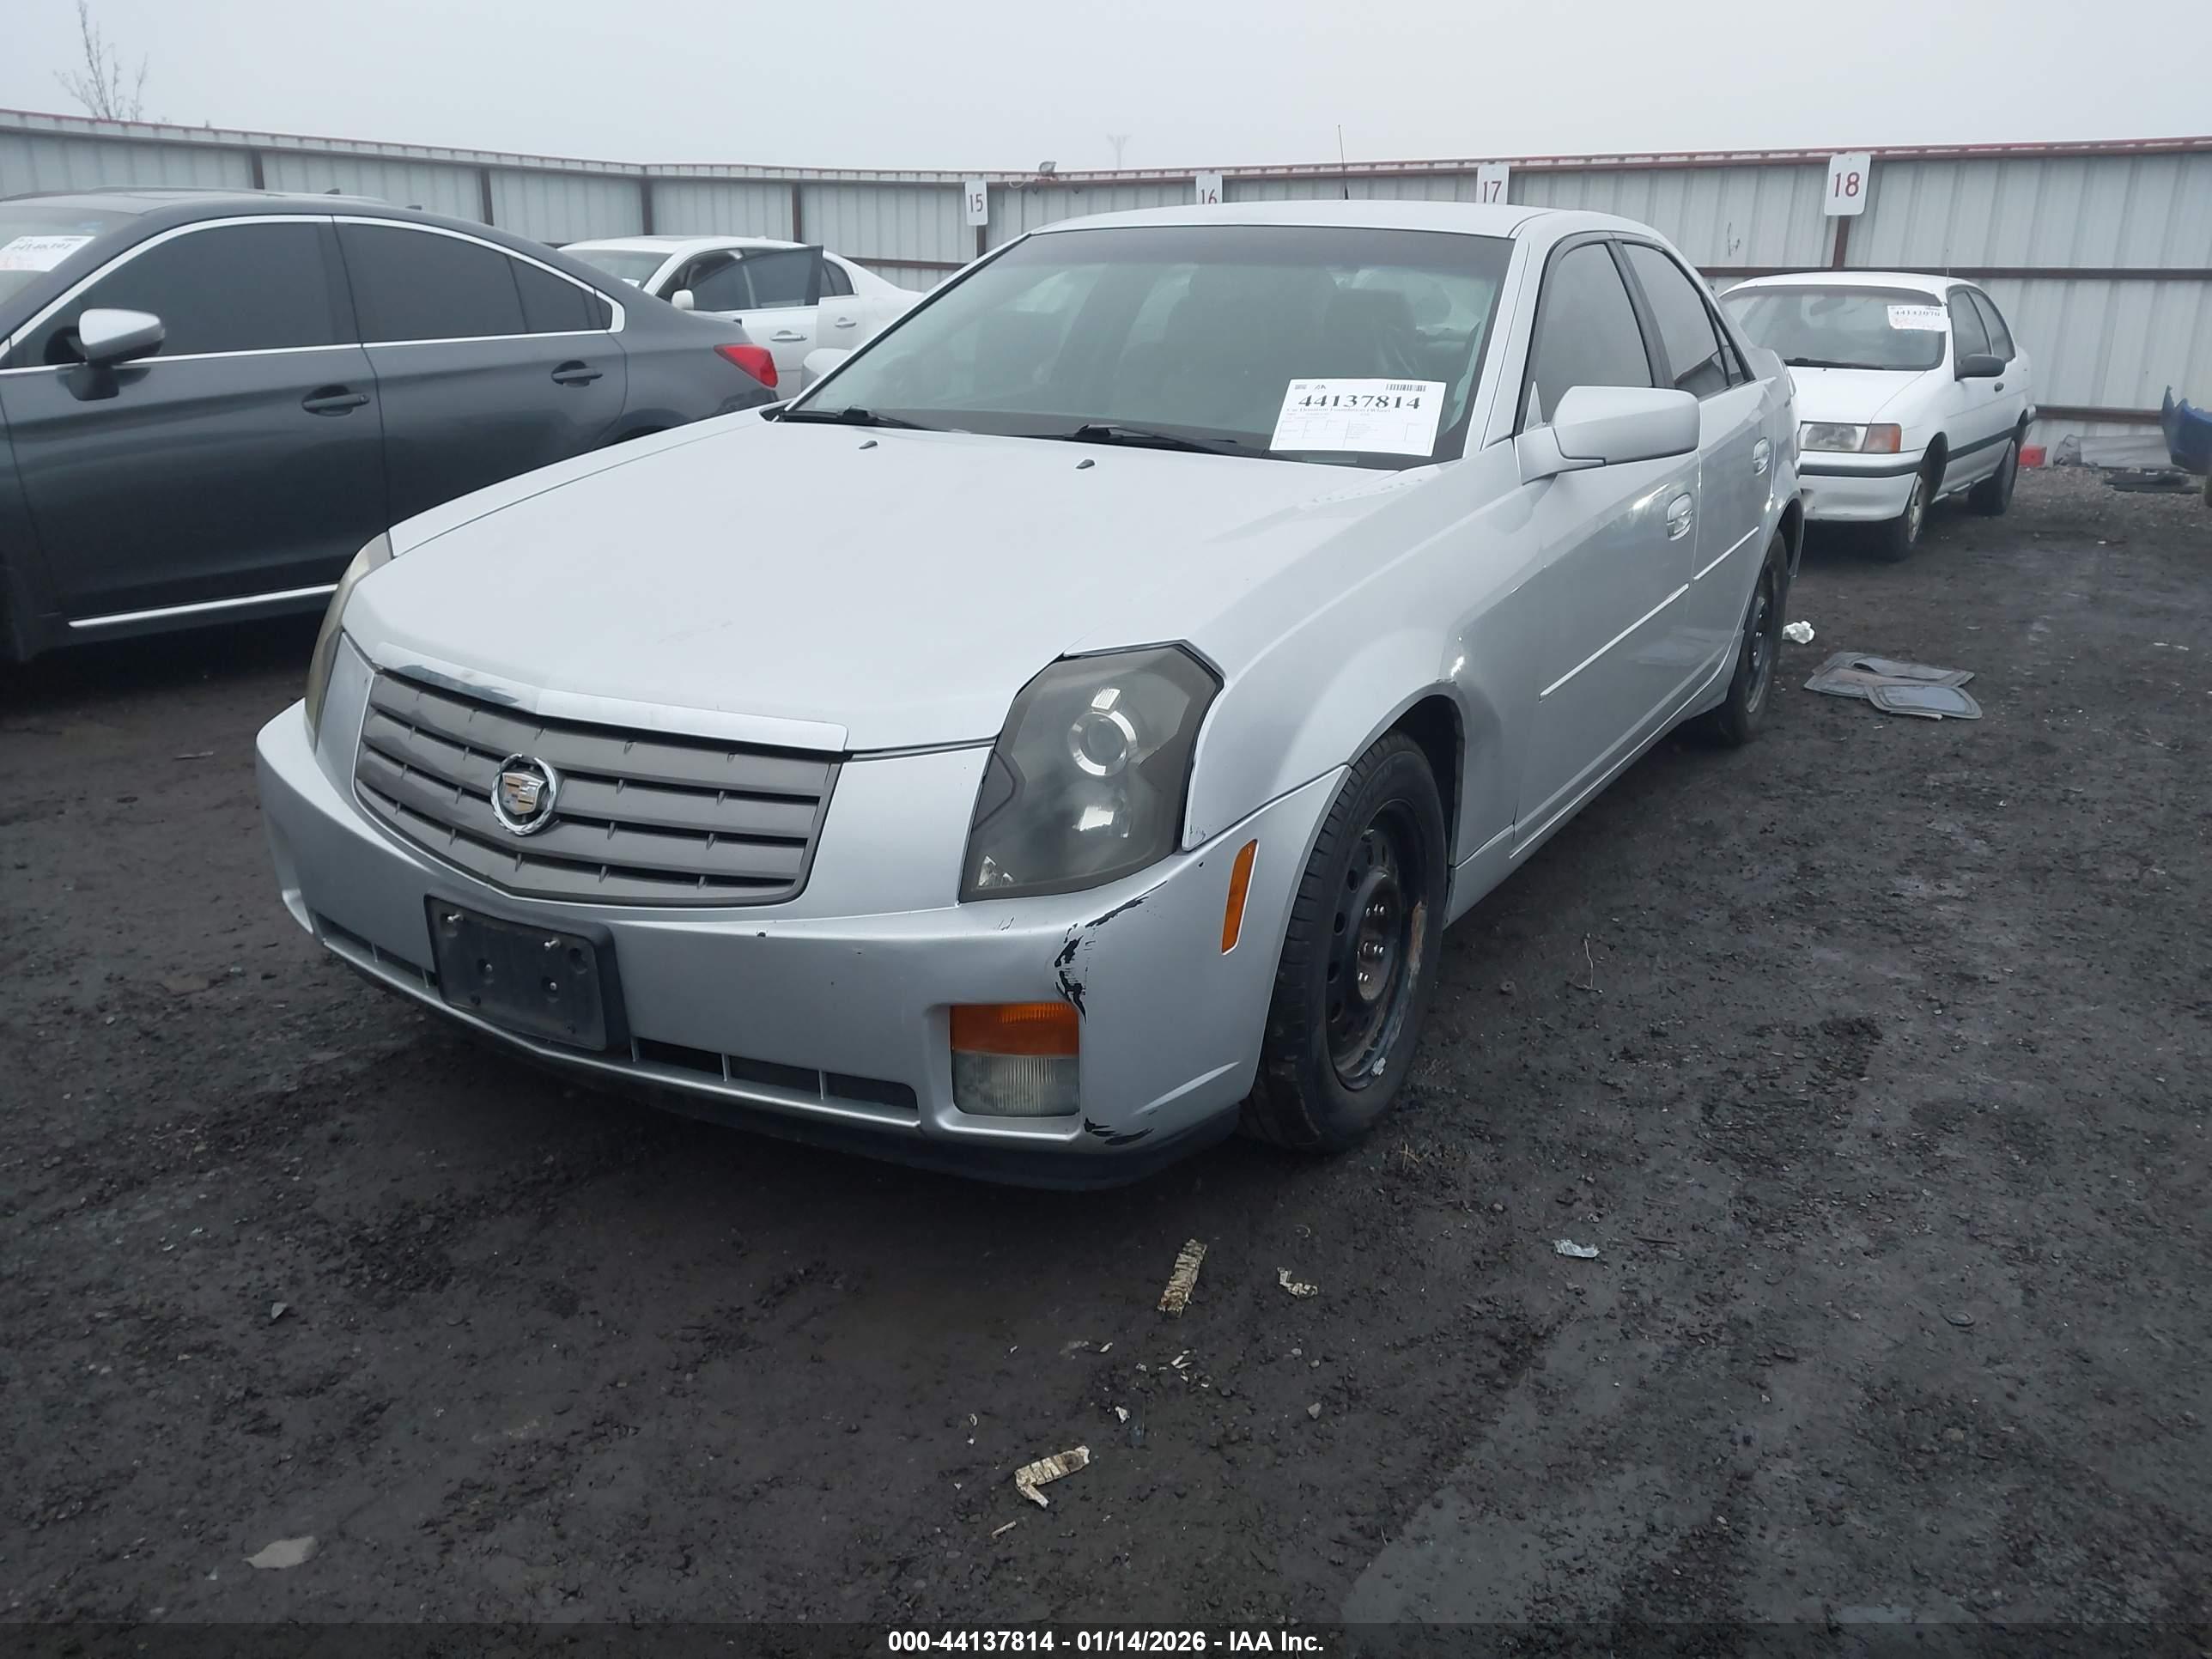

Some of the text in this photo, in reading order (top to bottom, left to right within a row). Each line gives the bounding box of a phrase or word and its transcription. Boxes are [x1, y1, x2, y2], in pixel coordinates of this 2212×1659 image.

[1483, 180, 1502, 204] 17
[1834, 172, 1860, 198] 18
[969, 193, 983, 213] 15
[1201, 189, 1217, 204] 16
[1297, 394, 1420, 410] 44137814
